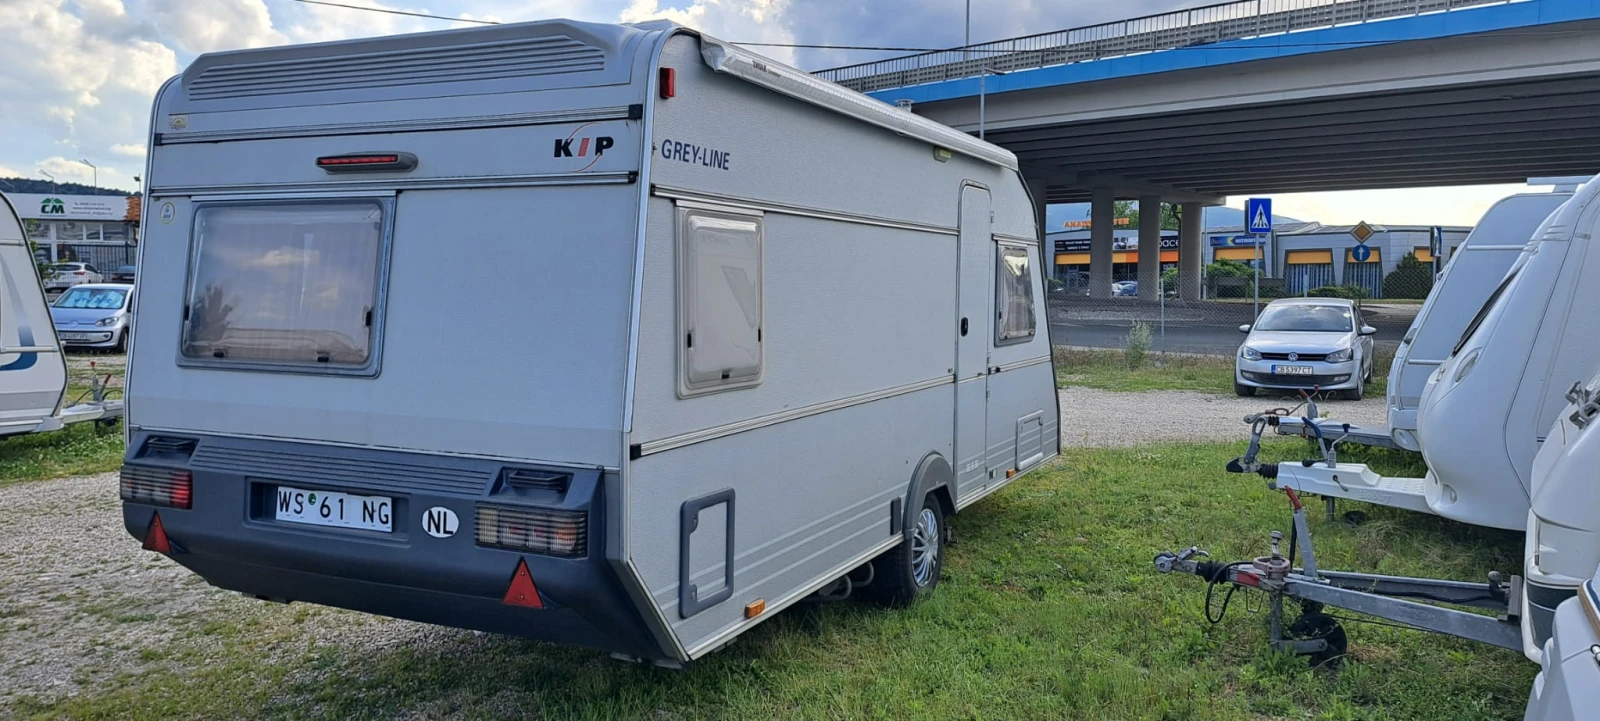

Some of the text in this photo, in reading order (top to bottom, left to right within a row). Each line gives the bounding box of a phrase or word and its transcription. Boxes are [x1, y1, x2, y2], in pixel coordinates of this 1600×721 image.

[553, 136, 614, 158] KIP
[661, 139, 731, 171] GREY-LINE
[41, 204, 65, 214] CM
[278, 490, 390, 525] WS 61 NG
[427, 509, 455, 536] NL
